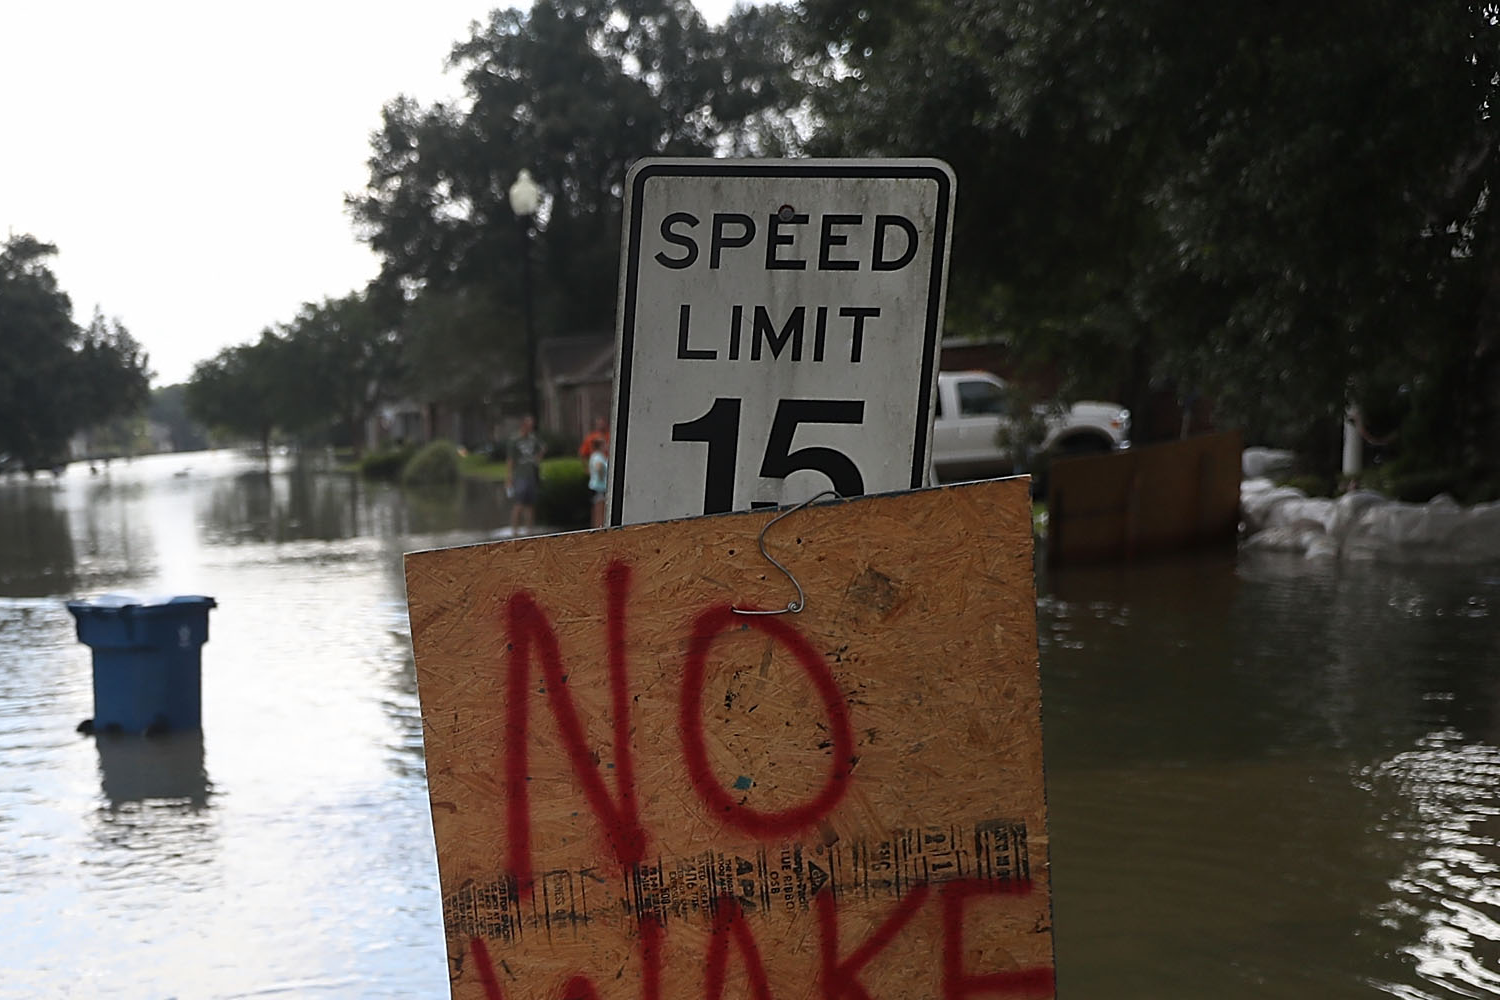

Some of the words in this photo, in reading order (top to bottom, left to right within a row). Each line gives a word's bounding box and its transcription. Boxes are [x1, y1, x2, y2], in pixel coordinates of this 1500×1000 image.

[654, 211, 919, 272] SPEED
[676, 304, 881, 363] LIMIT
[671, 397, 866, 515] 15
[504, 558, 855, 899] NO
[769, 870, 781, 894] OSB
